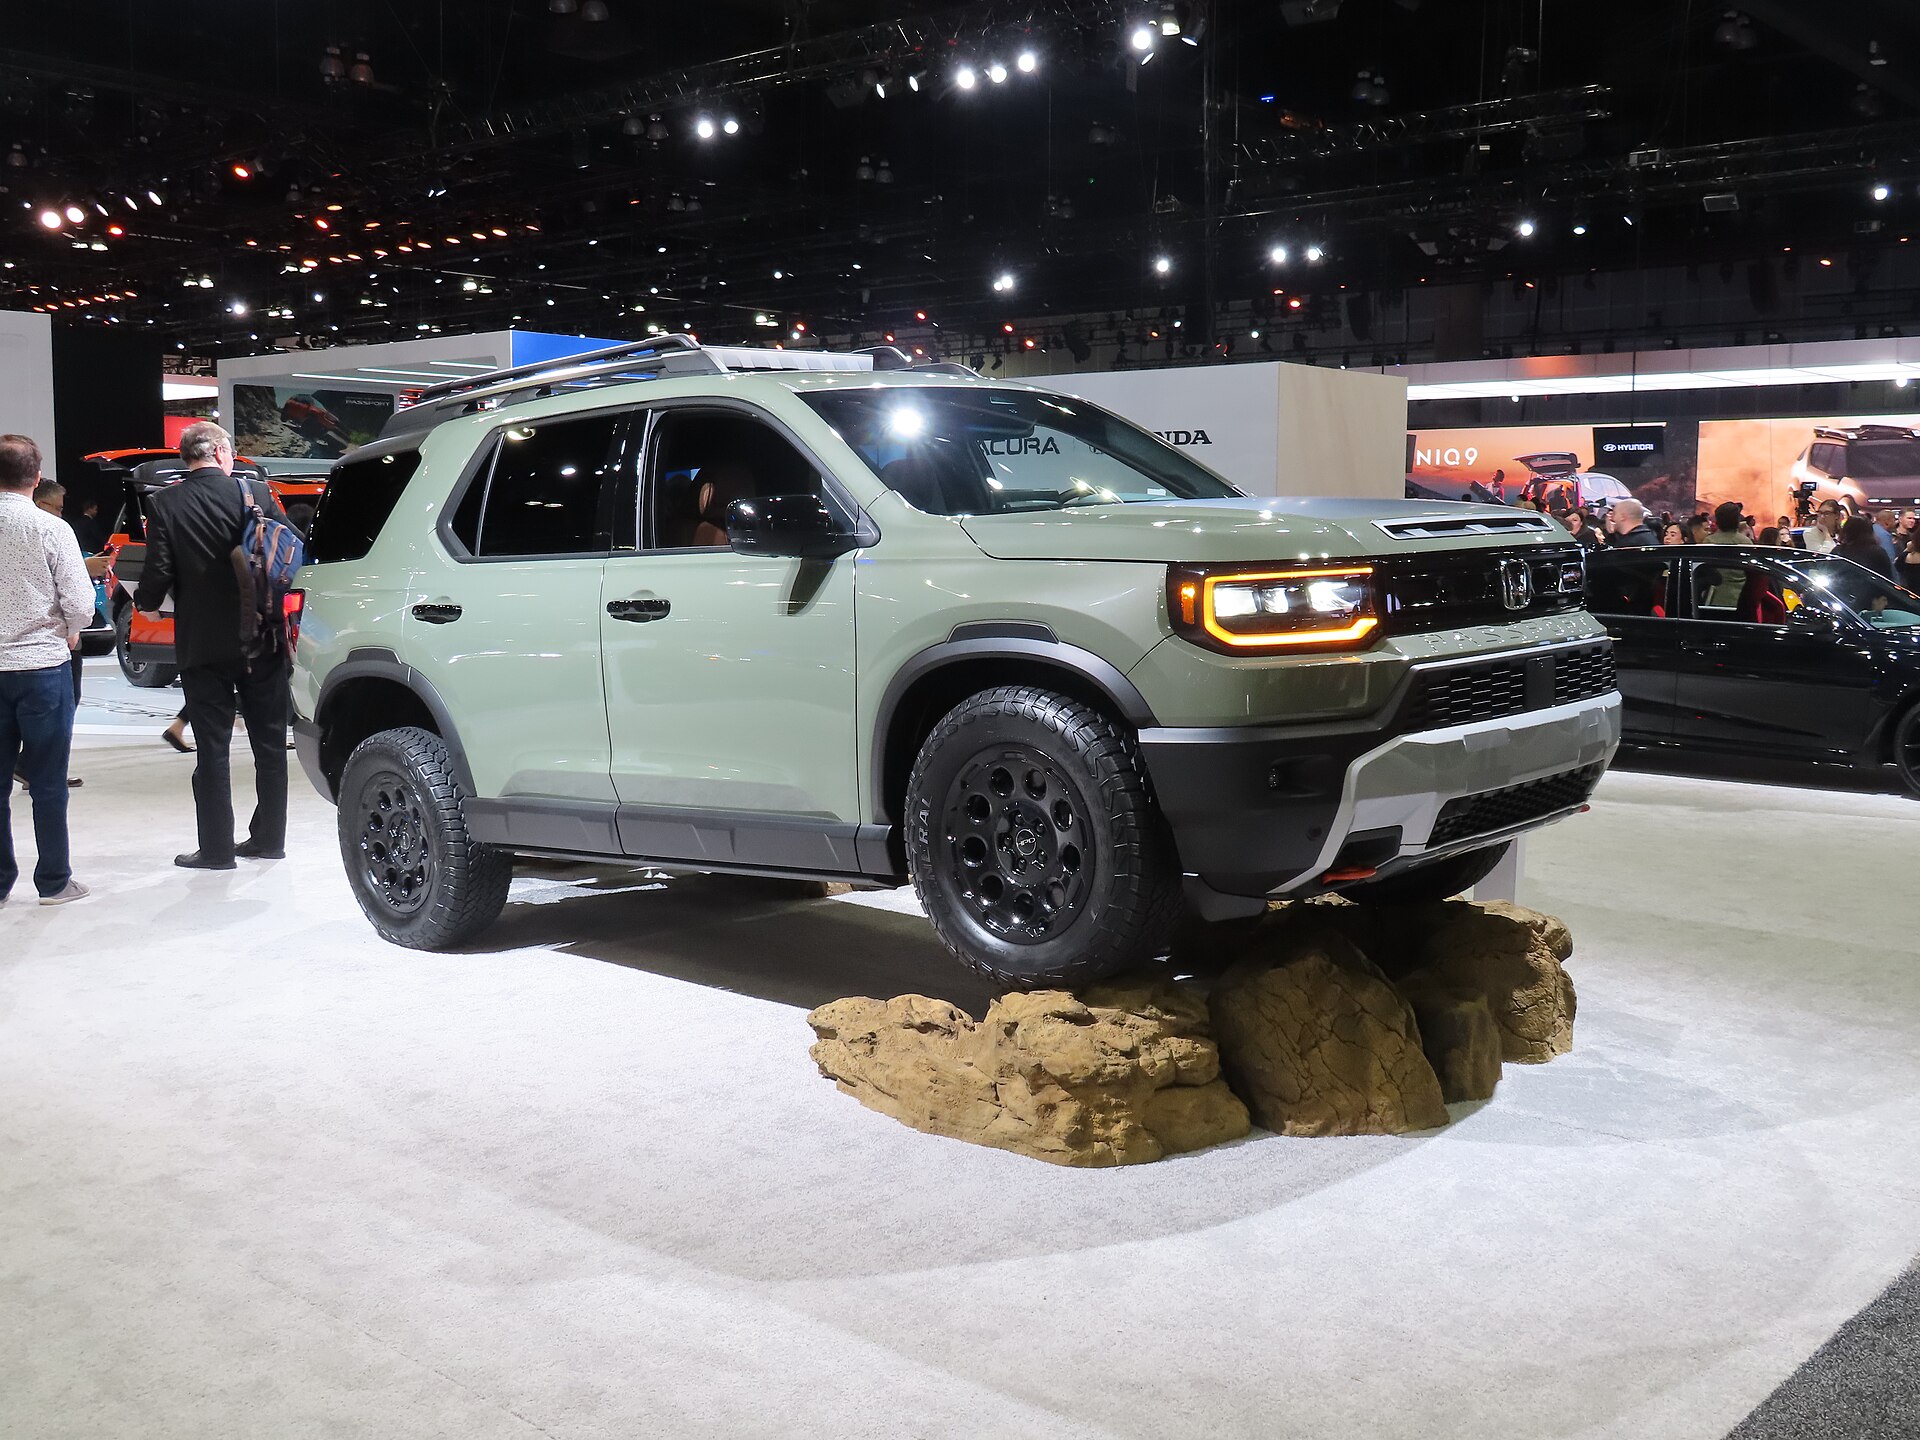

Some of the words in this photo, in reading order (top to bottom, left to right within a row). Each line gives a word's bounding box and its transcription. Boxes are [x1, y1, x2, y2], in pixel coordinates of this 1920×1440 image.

[345, 399, 390, 407] PASSPORT
[1153, 429, 1213, 446] NDA
[1617, 443, 1654, 451] HYUNDAI
[1418, 614, 1592, 654] PASSPORT
